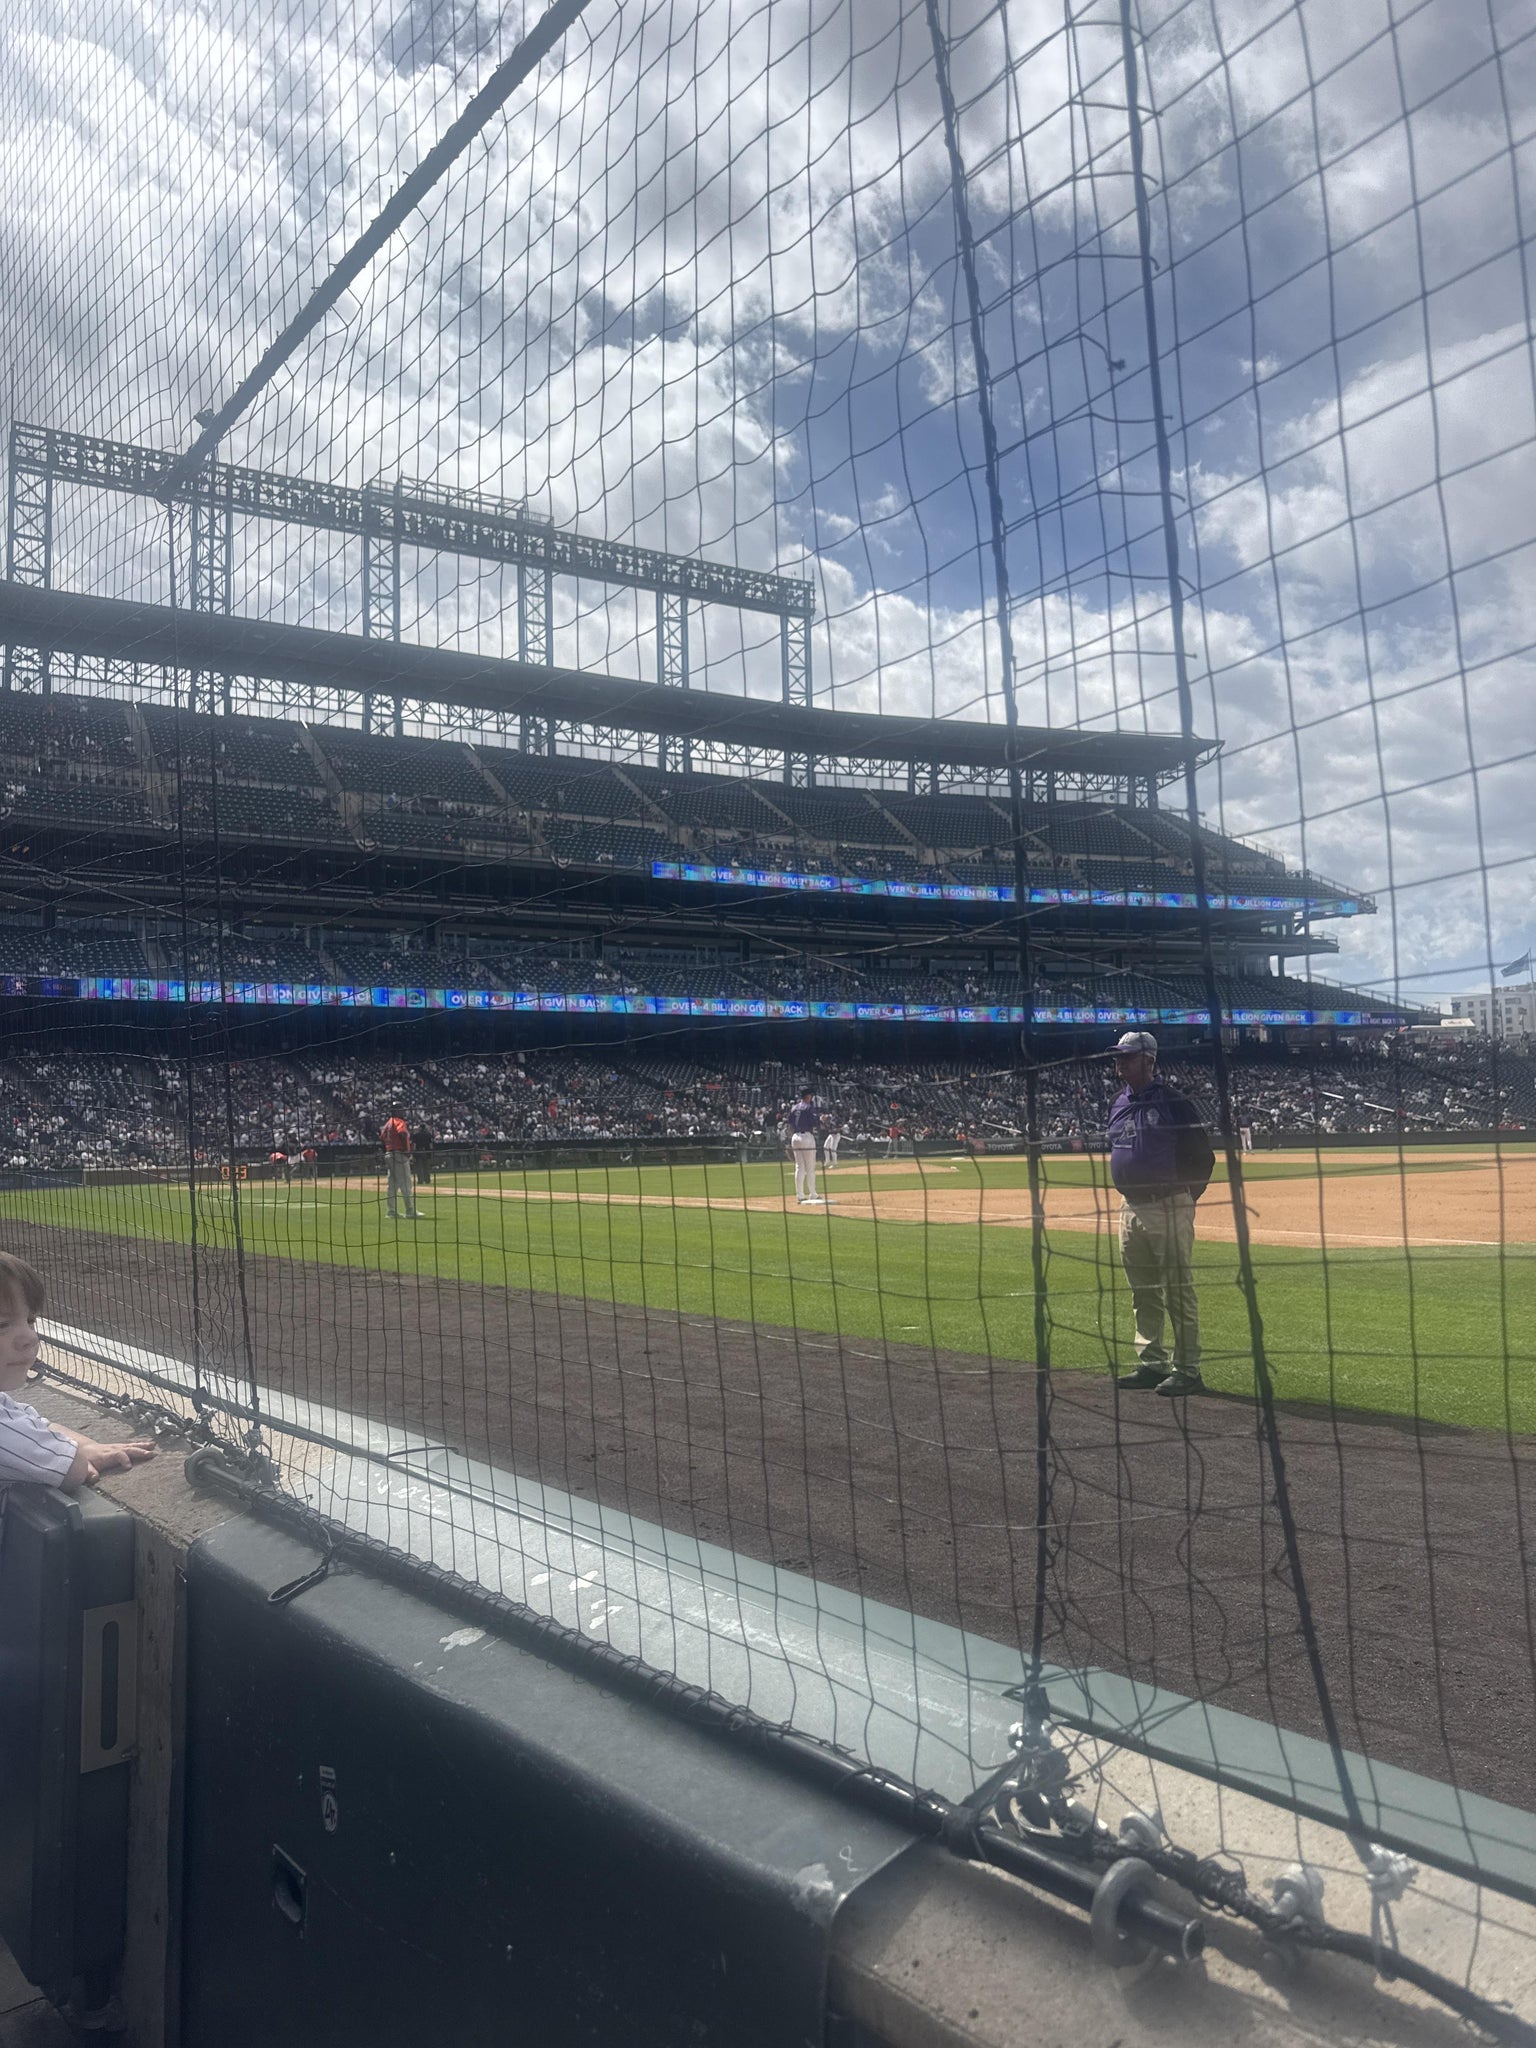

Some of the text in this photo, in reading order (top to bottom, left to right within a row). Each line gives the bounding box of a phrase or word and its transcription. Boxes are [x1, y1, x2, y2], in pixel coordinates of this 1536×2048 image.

[746, 873, 780, 884] BILLION
[949, 889, 975, 897] GIVEN
[976, 890, 999, 898] BACK
[451, 994, 483, 1005] OVER
[578, 999, 607, 1009] BACK
[671, 1002, 697, 1010] OVER
[857, 1007, 880, 1016] OVER
[1064, 1012, 1096, 1020] BILLION
[1260, 1013, 1284, 1022] GIVEN
[1284, 1013, 1306, 1022] BACK
[987, 1142, 1017, 1152] TOYOTA
[1040, 1142, 1063, 1151] OYOTA
